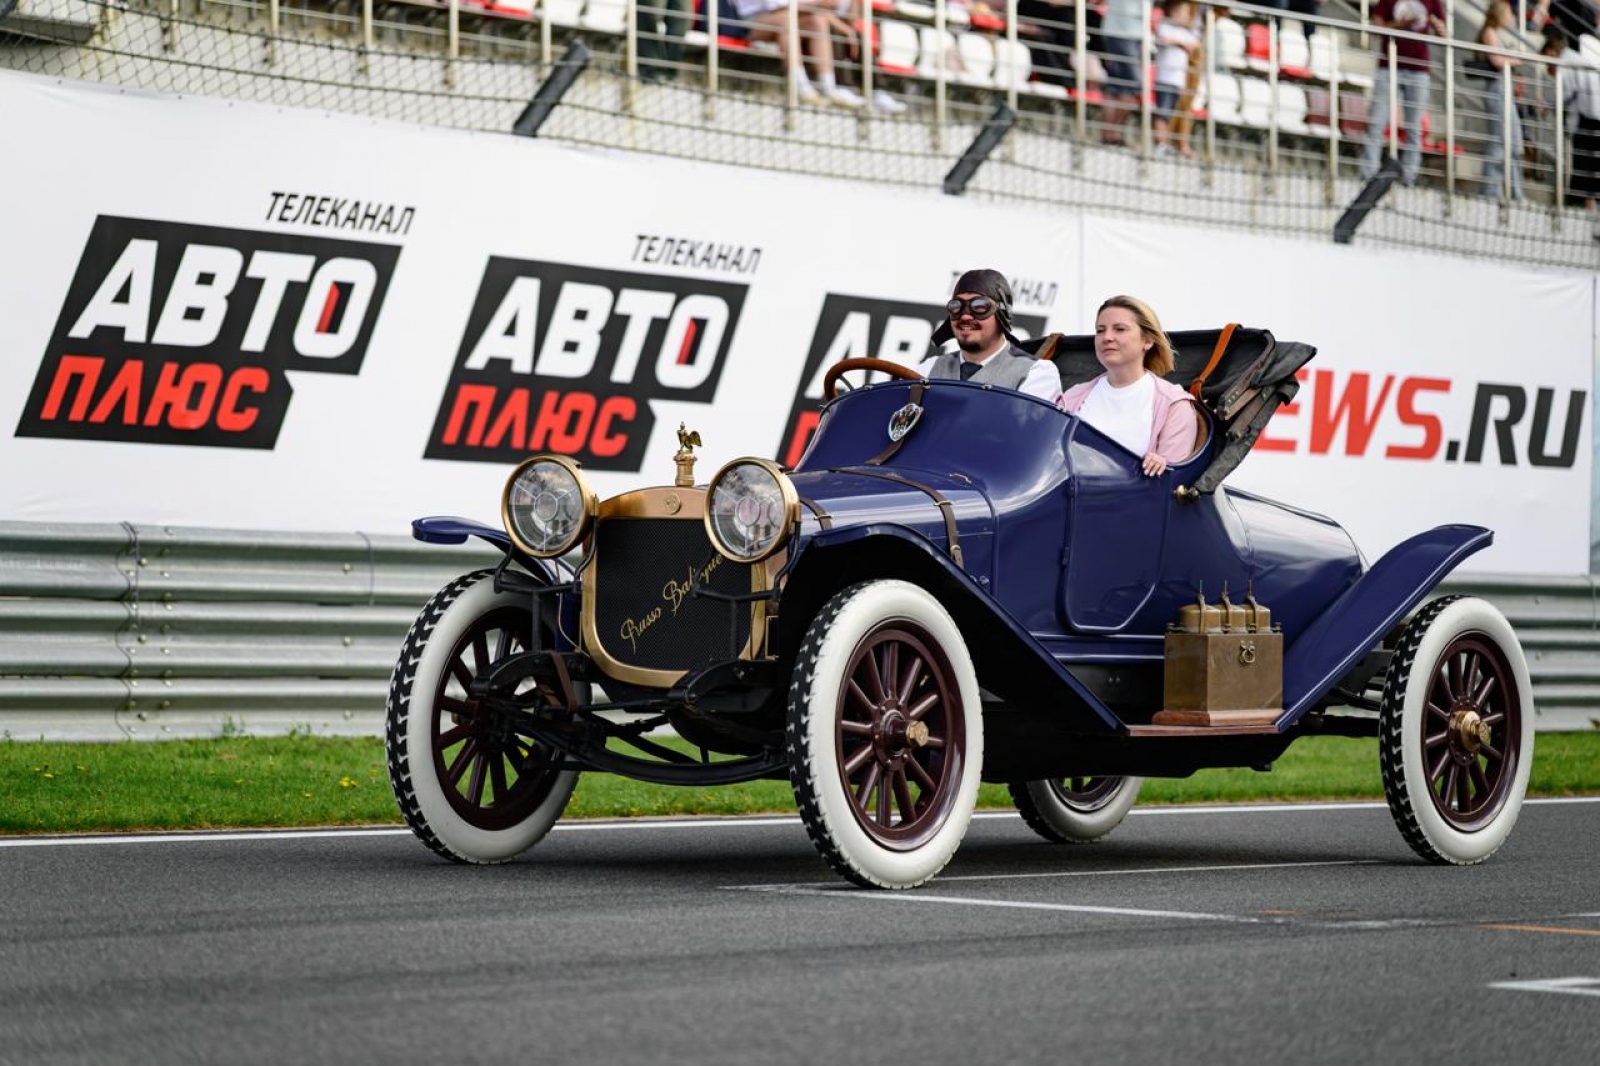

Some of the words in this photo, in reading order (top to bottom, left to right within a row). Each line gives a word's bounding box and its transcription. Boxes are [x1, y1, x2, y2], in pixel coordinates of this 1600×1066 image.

[265, 191, 416, 235] ТЕЛЕКАНАЛ
[631, 235, 762, 274] ТЕЛЕКАНАЛ
[66, 238, 378, 358] АВТО
[463, 276, 730, 389] АВТО
[39, 354, 271, 431] ПЛЮС
[441, 384, 637, 457] ПЛЮС
[620, 606, 662, 655] Russo
